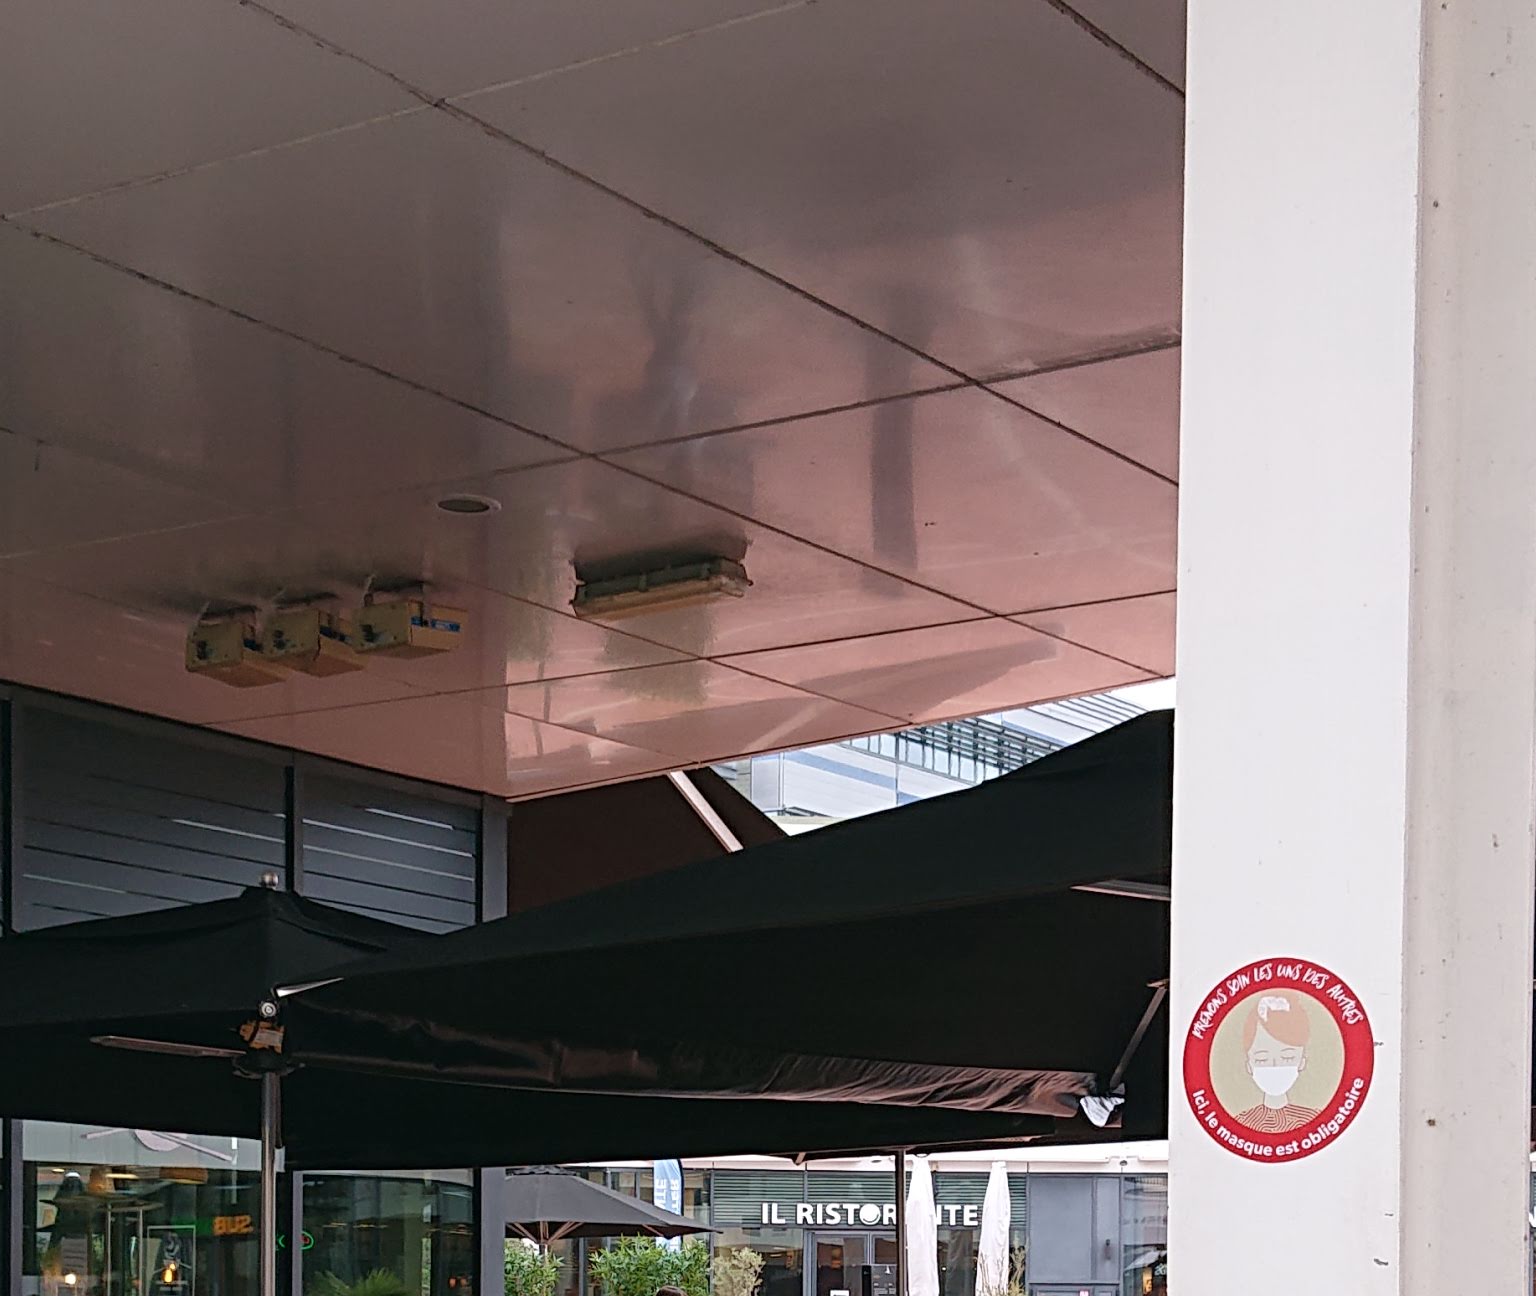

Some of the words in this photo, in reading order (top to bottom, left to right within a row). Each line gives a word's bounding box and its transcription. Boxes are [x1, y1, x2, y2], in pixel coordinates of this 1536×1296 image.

[1192, 988, 1228, 1040] PRENONS
[1226, 971, 1251, 997] SOIN
[1253, 963, 1273, 982] LES
[1277, 963, 1303, 981] UNS
[1302, 967, 1330, 990] DES
[1327, 983, 1364, 1026] AUTRES
[1205, 1111, 1218, 1129] le
[1216, 1123, 1273, 1157] masque
[1275, 1140, 1300, 1157] est
[1301, 1077, 1364, 1150] obligatoire
[762, 1202, 786, 1225] IL
